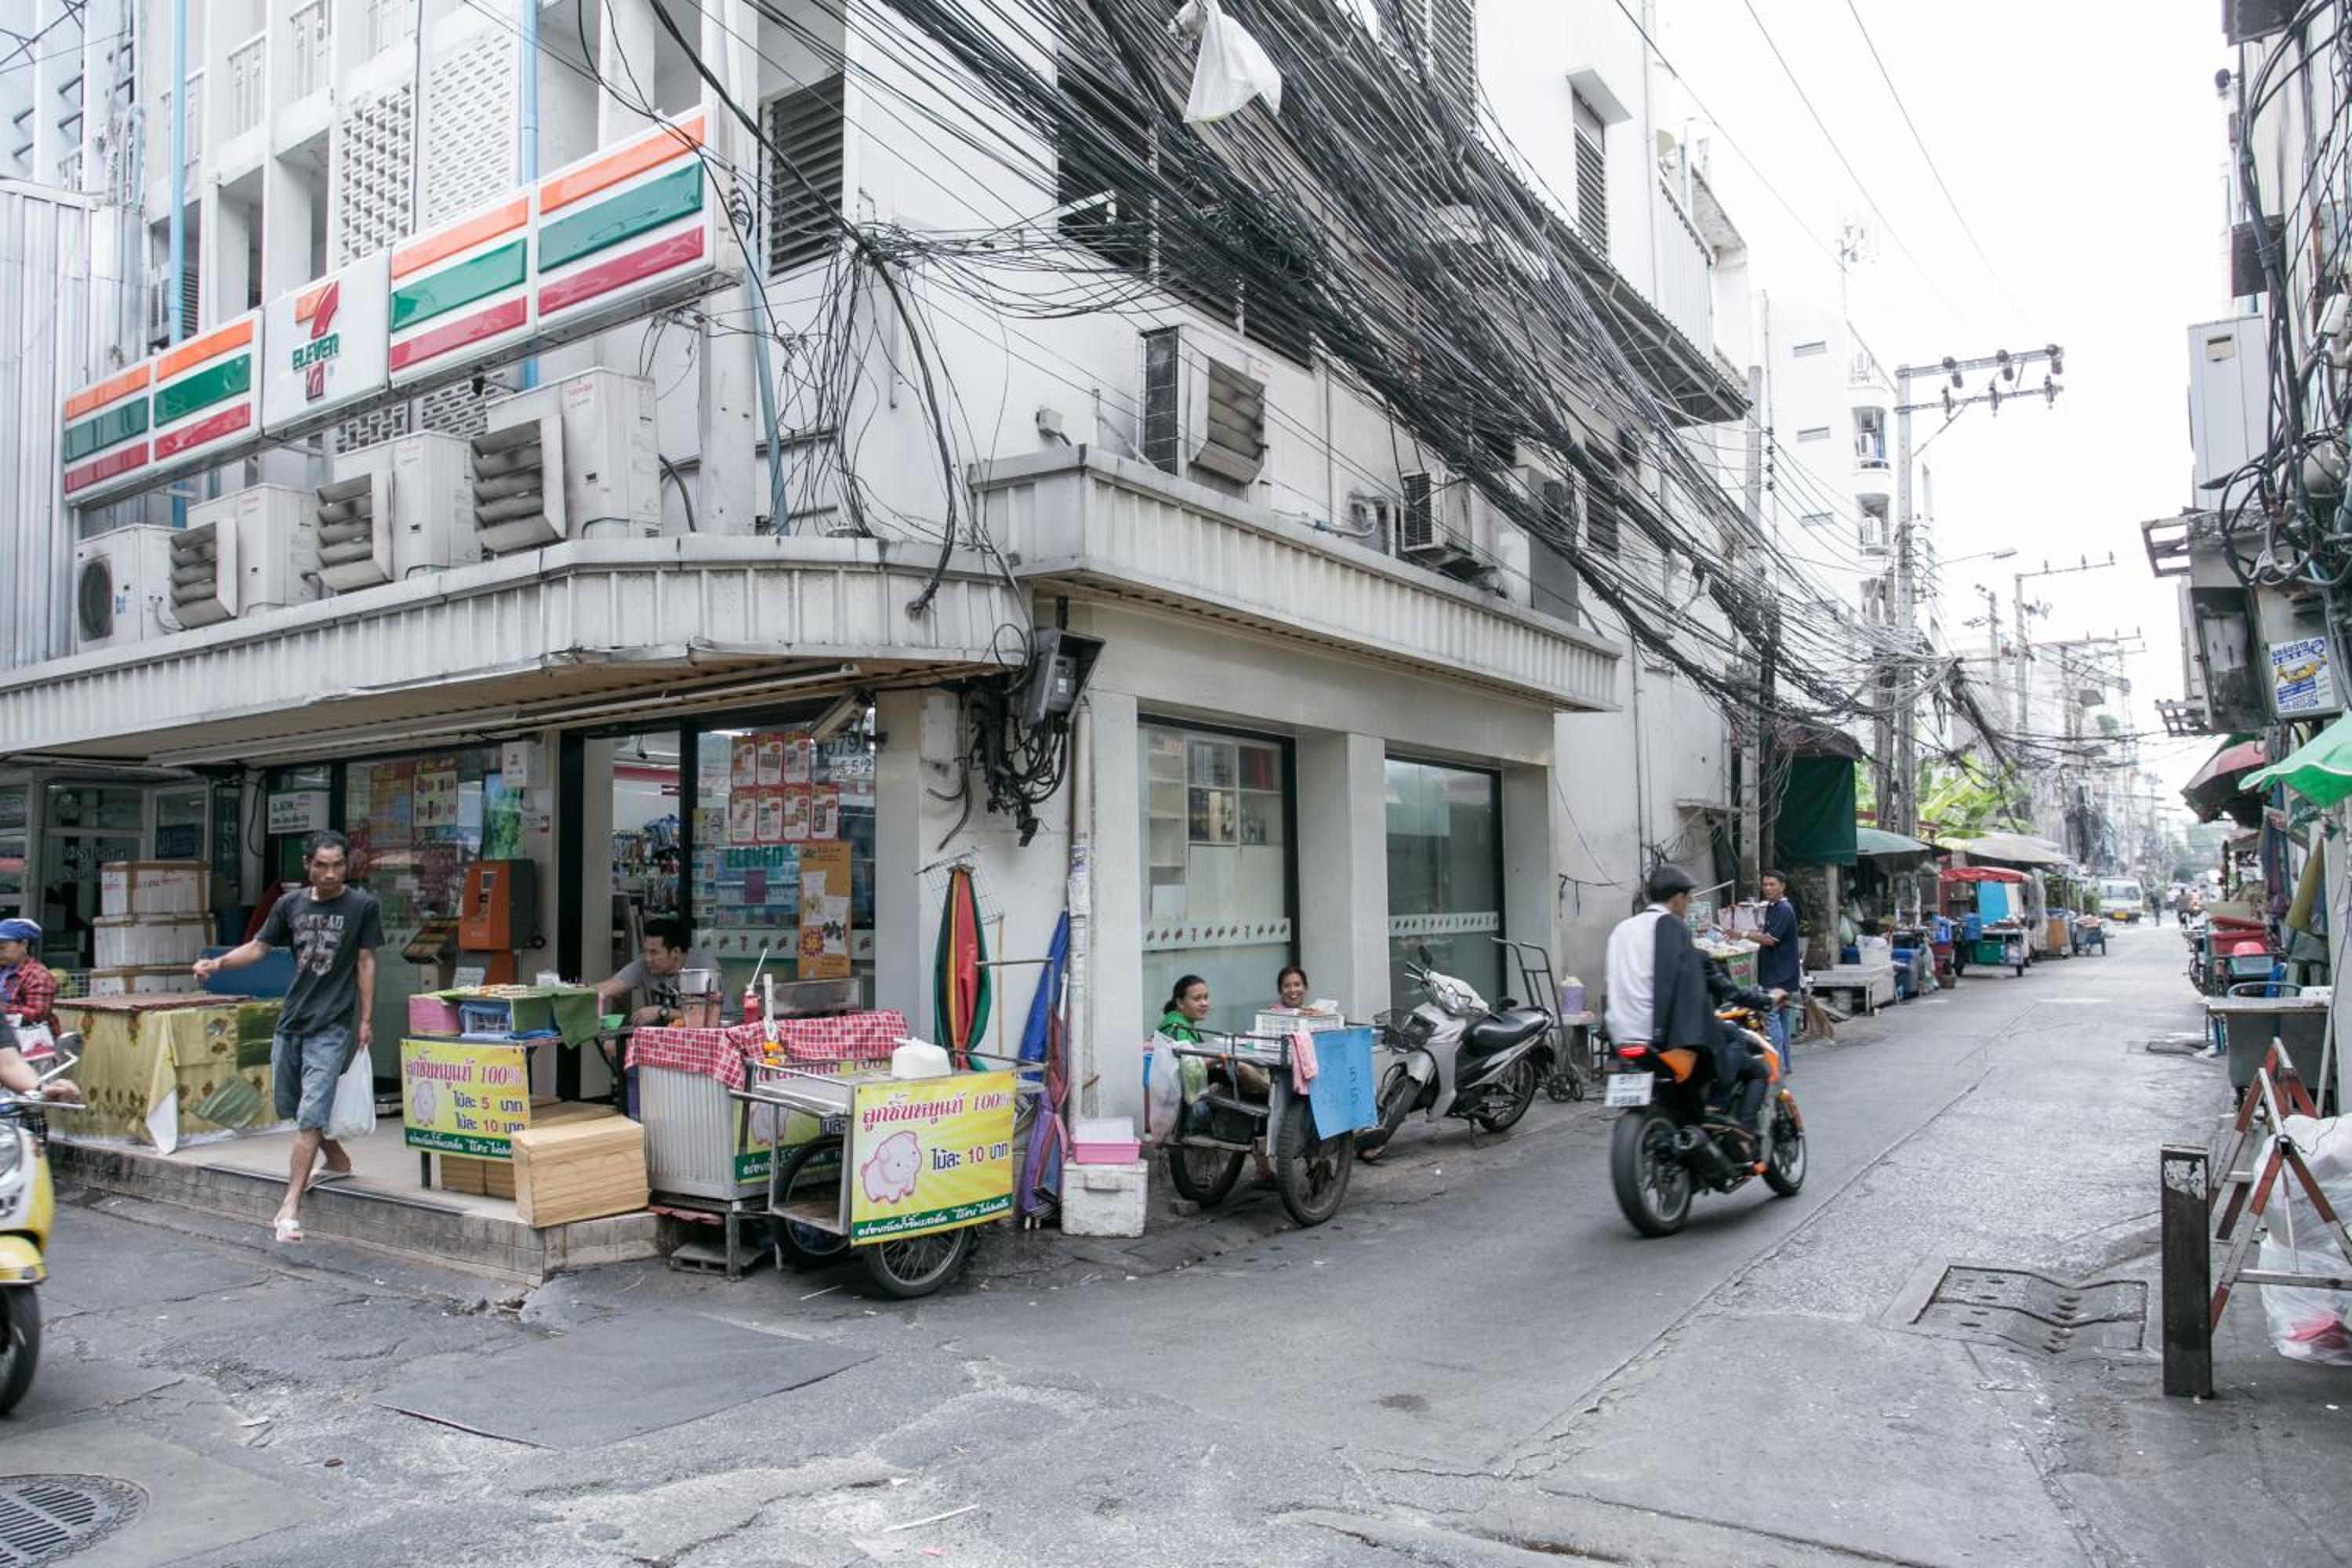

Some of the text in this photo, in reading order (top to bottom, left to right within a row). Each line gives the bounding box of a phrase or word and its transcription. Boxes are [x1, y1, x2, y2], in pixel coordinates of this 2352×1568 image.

[481, 1097, 490, 1110] 5
[501, 1100, 523, 1112] บาท
[863, 1093, 966, 1132] ลูกชิ้นหมูแท้
[484, 1119, 498, 1132] 10
[968, 1145, 984, 1163] 10
[990, 1143, 1007, 1160] บาท
